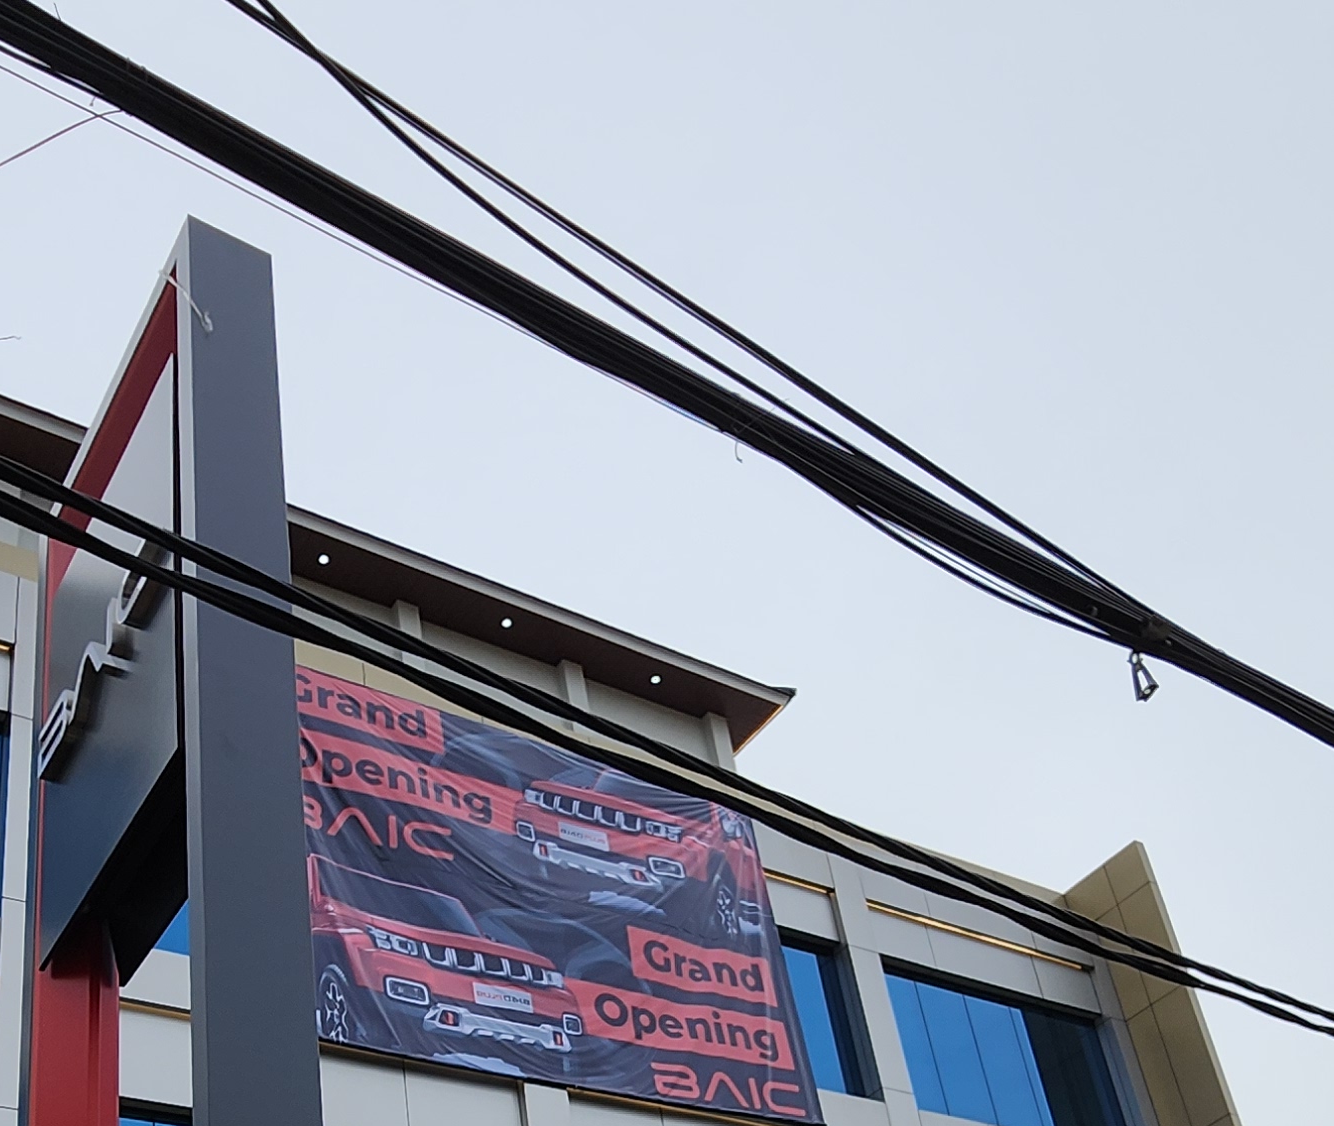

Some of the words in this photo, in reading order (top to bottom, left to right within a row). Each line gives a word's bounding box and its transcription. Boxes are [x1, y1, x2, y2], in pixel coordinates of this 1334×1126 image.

[643, 940, 765, 992] Grand
[594, 993, 779, 1062] Opening
[651, 1062, 806, 1117] BAIC
